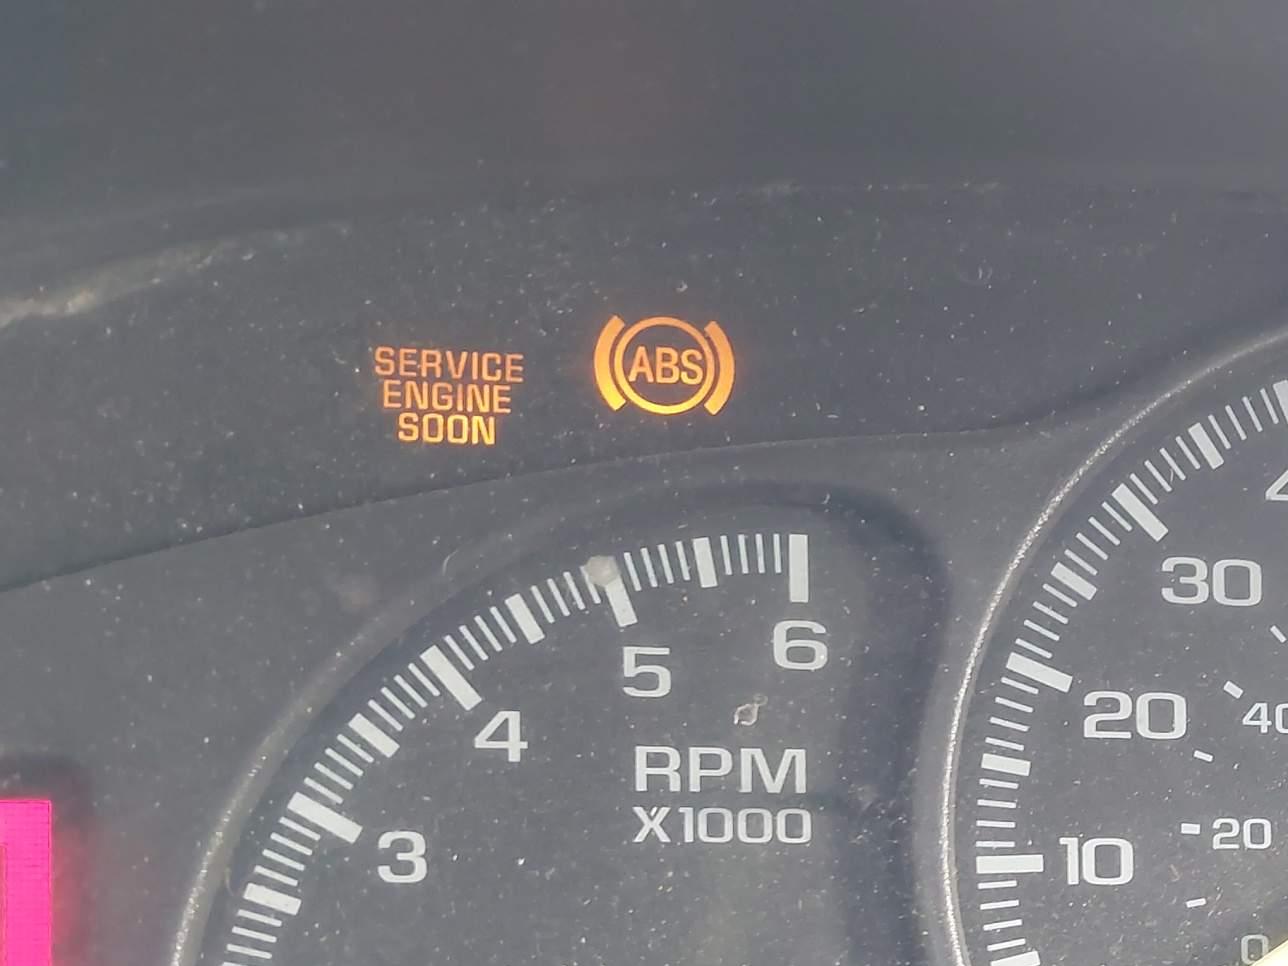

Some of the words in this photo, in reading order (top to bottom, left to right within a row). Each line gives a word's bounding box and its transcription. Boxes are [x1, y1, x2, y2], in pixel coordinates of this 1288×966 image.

[374, 346, 524, 383] SERVICE
[628, 345, 704, 385] ABS
[382, 379, 512, 413] ENGINE
[397, 412, 496, 445] SOON
[1160, 556, 1263, 607] 30
[772, 620, 829, 671] 6
[622, 646, 672, 698] 5
[473, 710, 529, 763] 4
[1082, 690, 1188, 741] 20
[634, 745, 807, 795] RPM
[632, 805, 813, 845] X1000
[1211, 817, 1273, 851] 20
[377, 830, 428, 883] 3
[1058, 837, 1135, 887] 10
[1241, 934, 1269, 965] 0
